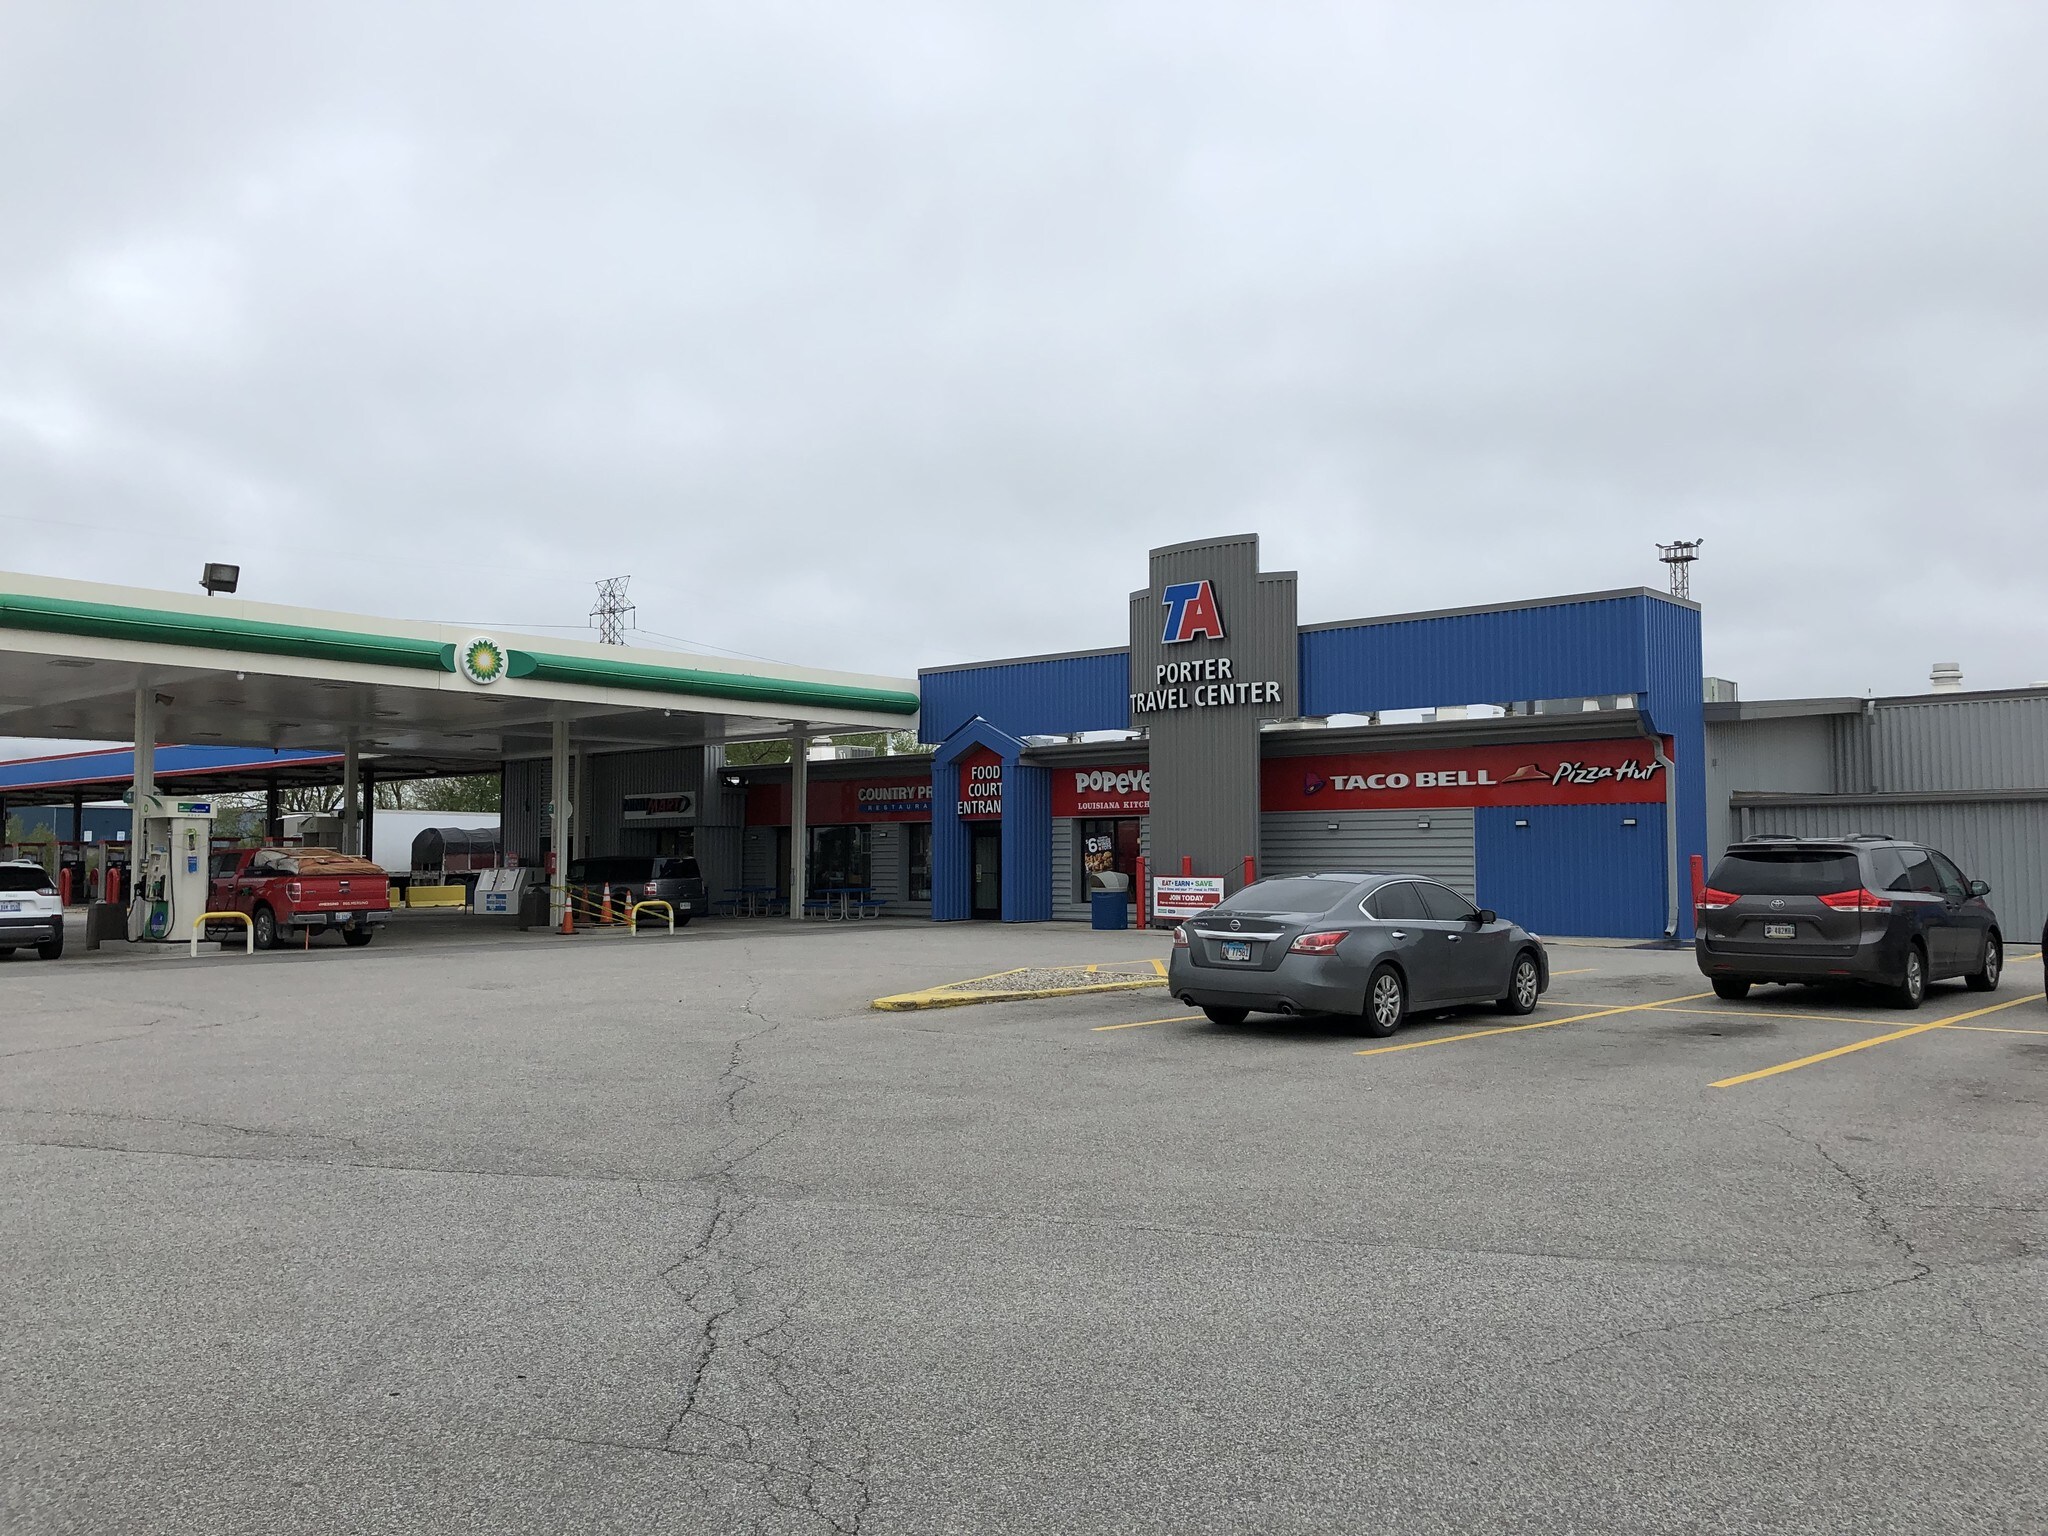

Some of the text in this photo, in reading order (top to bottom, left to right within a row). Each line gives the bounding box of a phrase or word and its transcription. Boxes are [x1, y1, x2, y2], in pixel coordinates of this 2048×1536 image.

[1161, 580, 1225, 645] TA
[1156, 658, 1233, 685] PORTER
[1130, 681, 1281, 714] TRAVEL CENTER
[971, 765, 1001, 780] FOOD
[1329, 769, 1498, 791] TACO BELL
[1552, 759, 1664, 786] Pizza Hut
[858, 786, 916, 801] COUNTRY
[968, 782, 1002, 797] COURT
[867, 803, 928, 811] RESTAURA
[957, 800, 1001, 815] ENTRAN
[1078, 801, 1150, 810] LOUISIANA KITCH
[1182, 894, 1204, 902] TODAY
